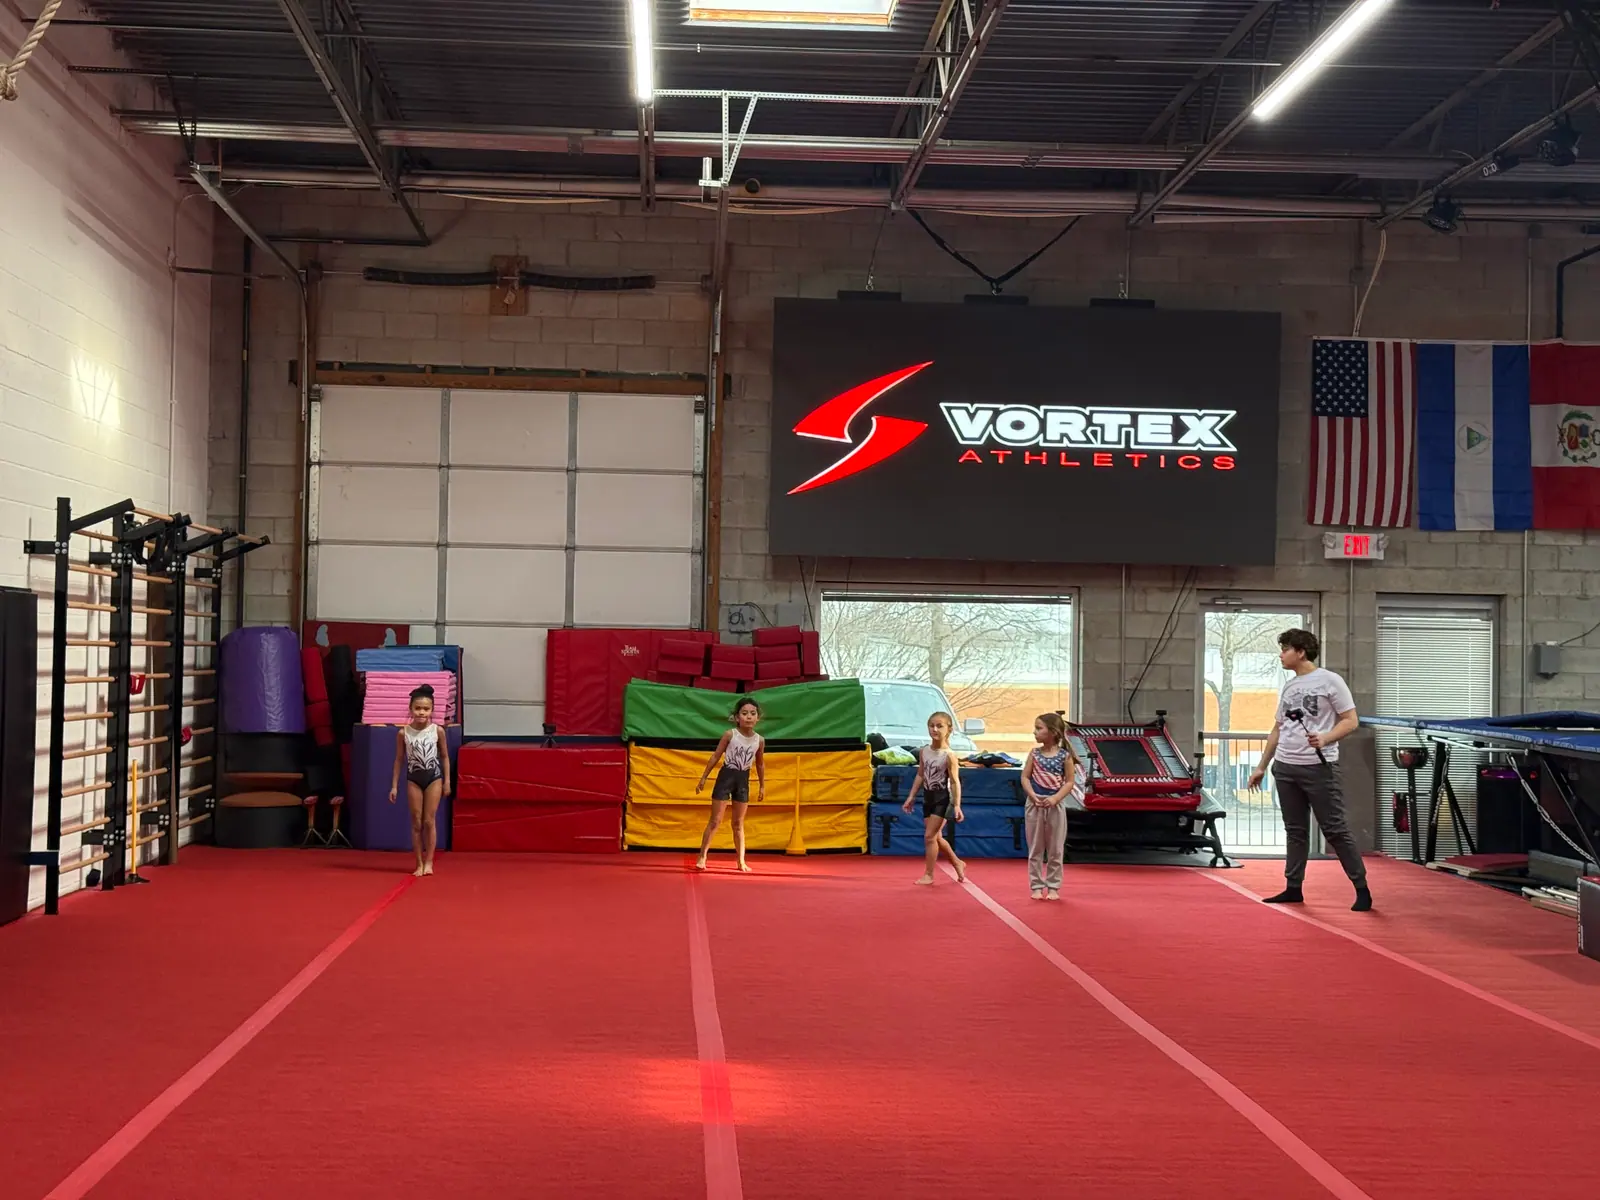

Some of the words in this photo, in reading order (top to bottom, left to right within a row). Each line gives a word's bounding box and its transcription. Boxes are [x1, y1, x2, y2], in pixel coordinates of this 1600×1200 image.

[940, 402, 1237, 451] VORTEX
[958, 449, 1236, 470] ATHLETICS
[1344, 534, 1370, 557] EXIT
